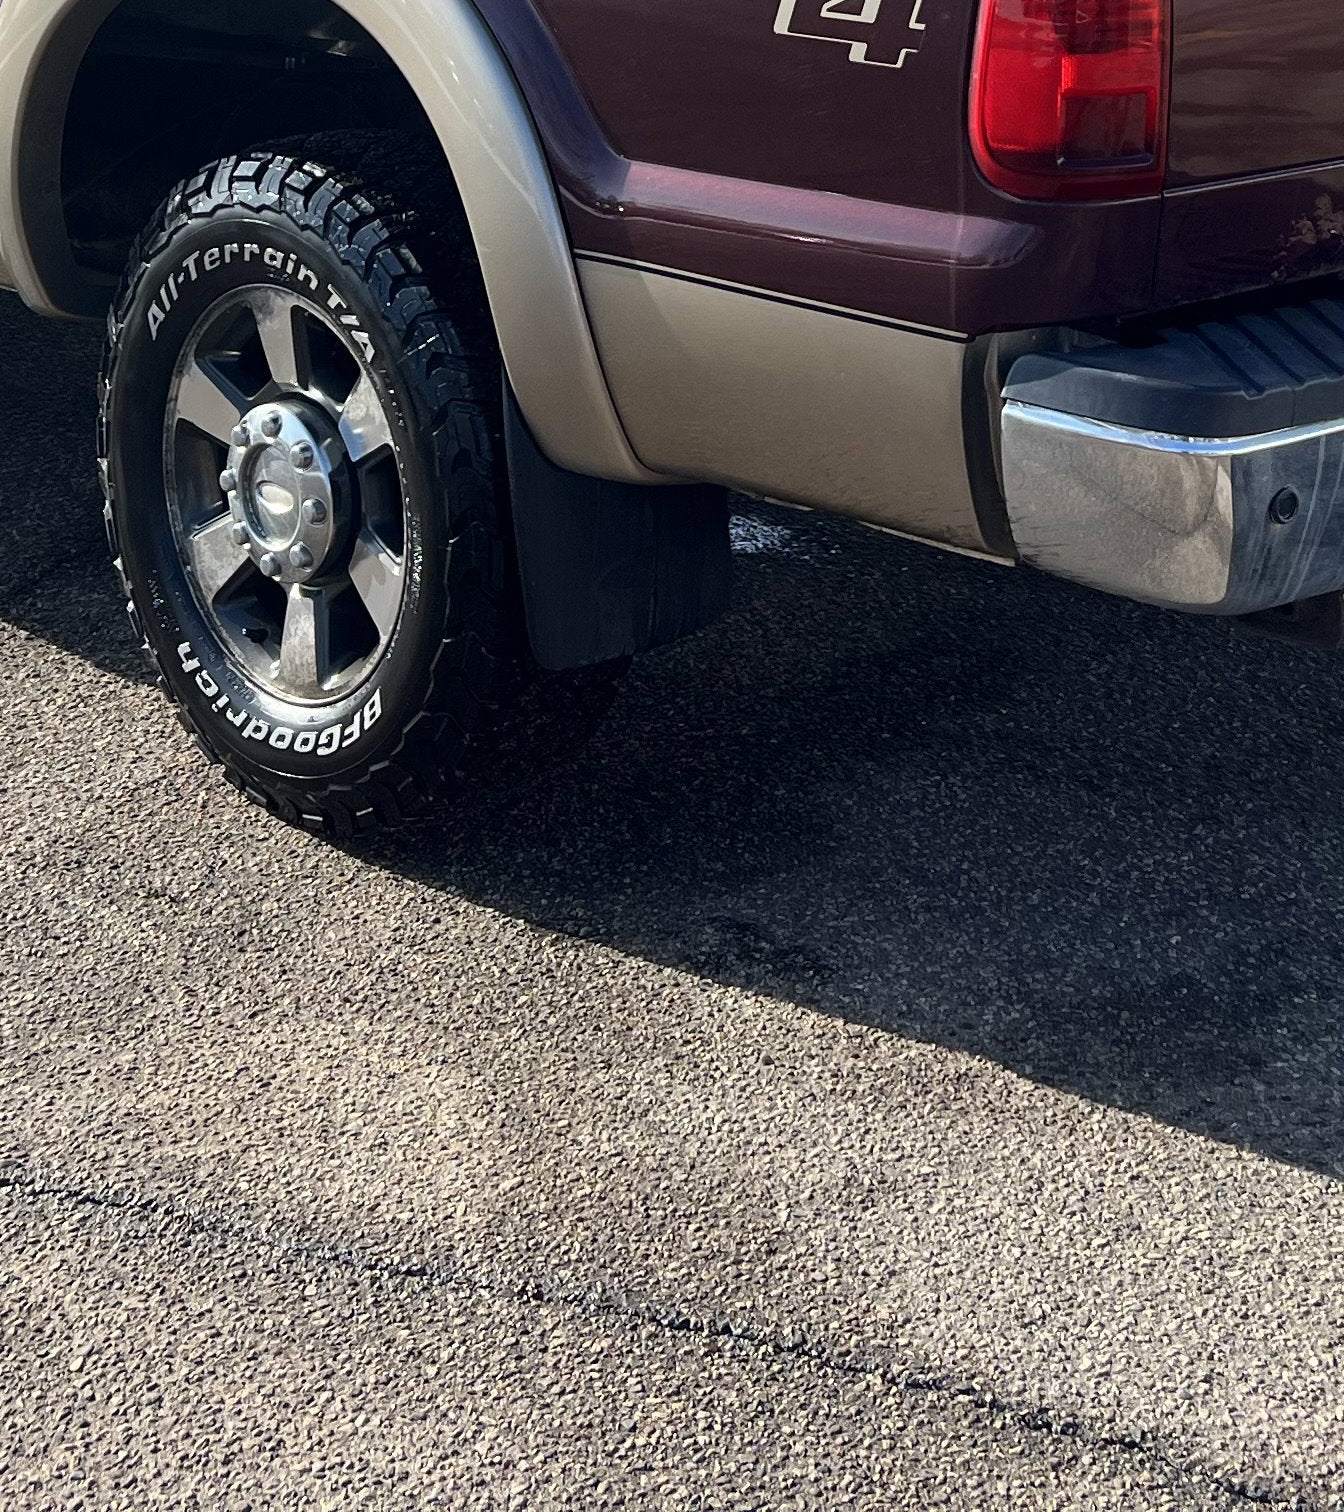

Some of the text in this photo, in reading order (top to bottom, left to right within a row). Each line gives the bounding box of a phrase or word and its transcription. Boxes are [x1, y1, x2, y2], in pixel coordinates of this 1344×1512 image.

[147, 242, 376, 363] All-Terrain T/A
[176, 641, 383, 756] BFGoodrich
